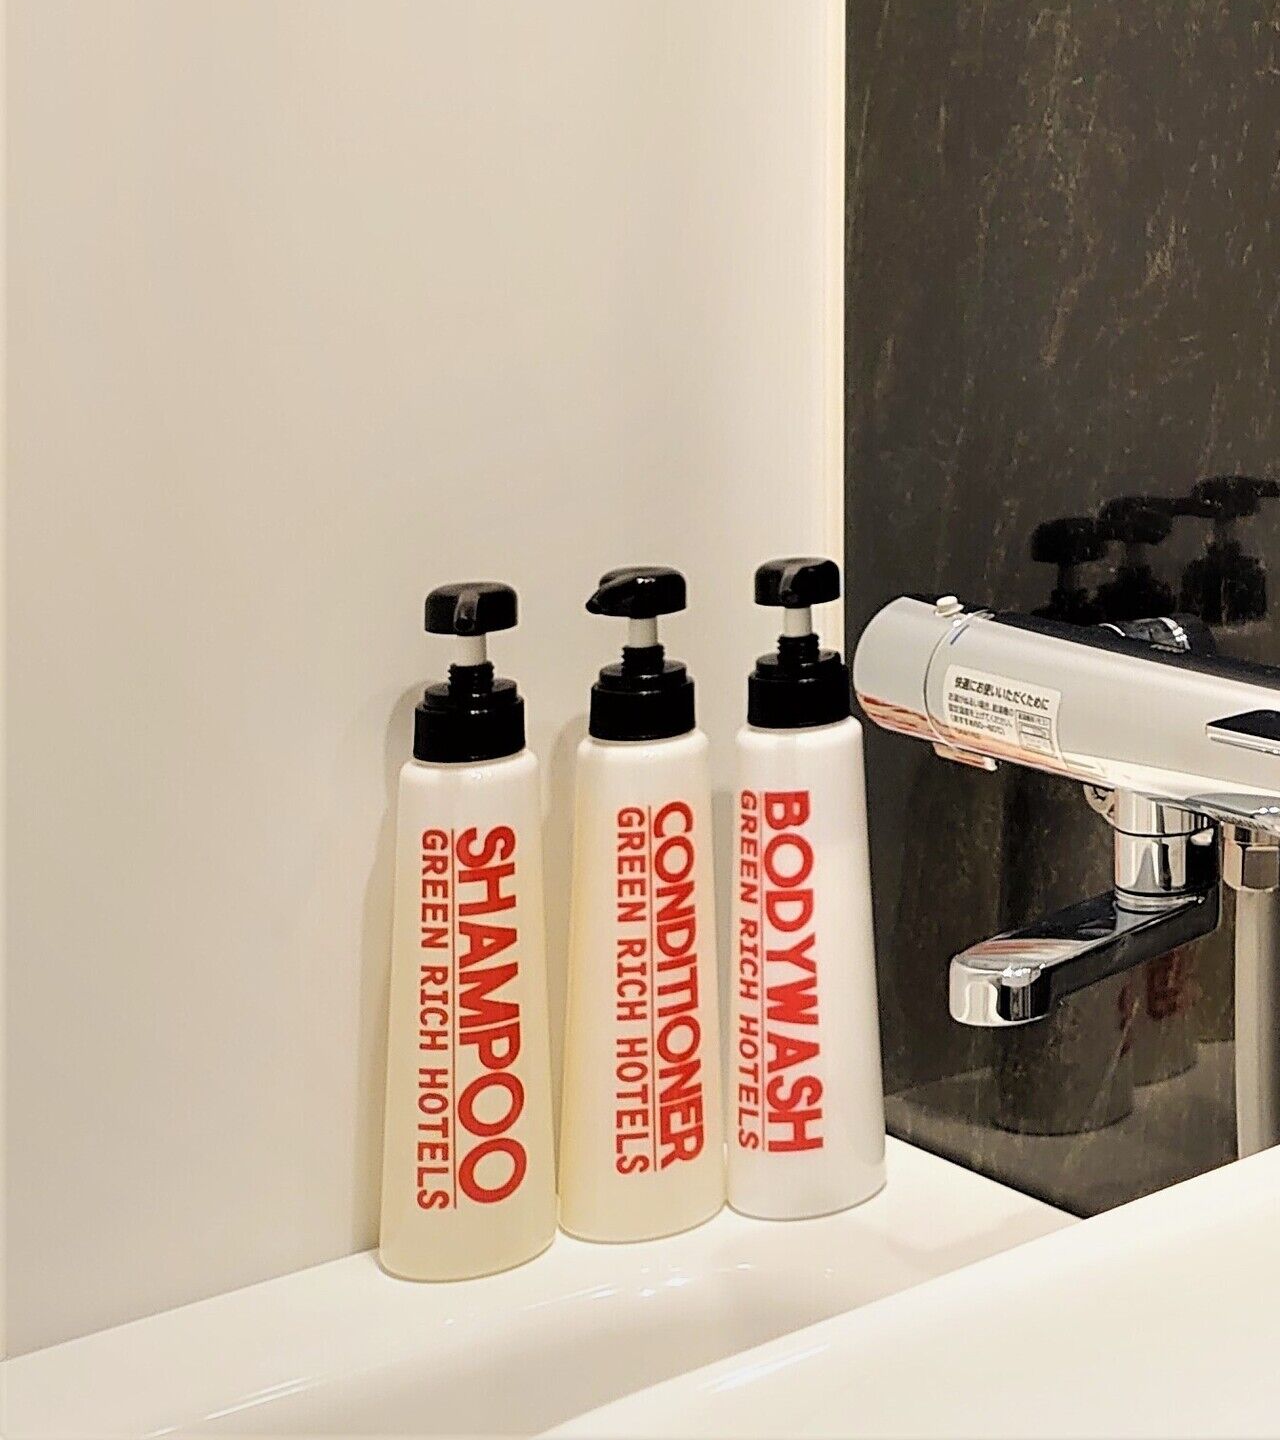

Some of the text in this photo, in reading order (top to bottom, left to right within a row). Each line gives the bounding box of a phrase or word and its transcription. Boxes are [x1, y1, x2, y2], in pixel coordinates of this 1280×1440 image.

[416, 828, 450, 1210] GREEN RICH HOTELS
[456, 825, 528, 1205] SHAMPOO
[615, 806, 650, 1175] GREEN RICH HOTELS
[654, 800, 706, 1171] CONDITIONER
[737, 788, 760, 1152] GREEN RICH HOTELS
[764, 789, 824, 1153] BODYWASH
